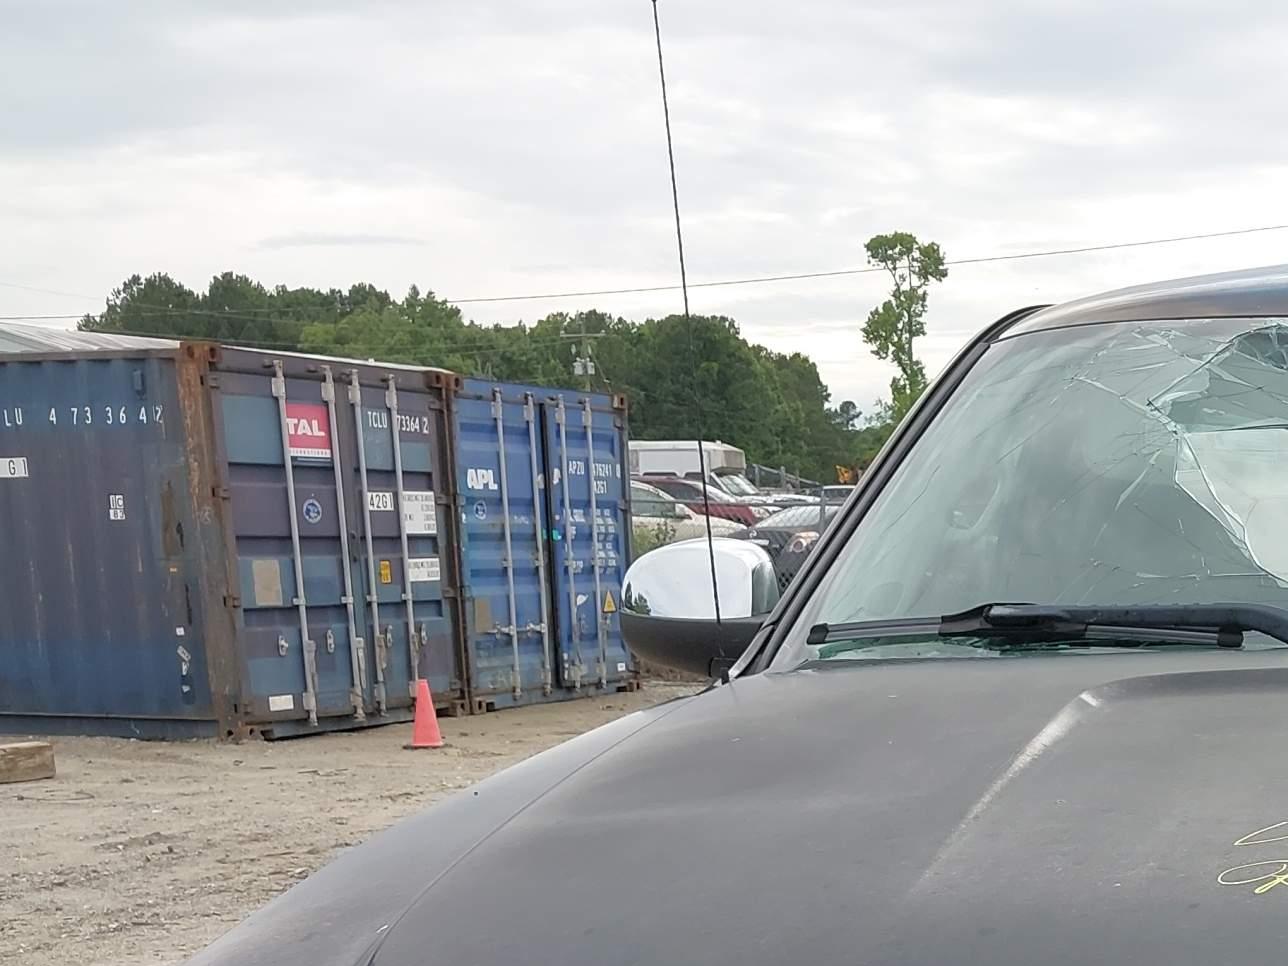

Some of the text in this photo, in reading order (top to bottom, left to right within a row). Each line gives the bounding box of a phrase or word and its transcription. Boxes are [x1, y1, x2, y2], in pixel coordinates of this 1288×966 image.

[286, 418, 326, 437] TAL
[367, 411, 388, 429] TCLU
[395, 414, 420, 433] 73364
[466, 468, 498, 490] APL
[369, 493, 393, 510] 42G1
